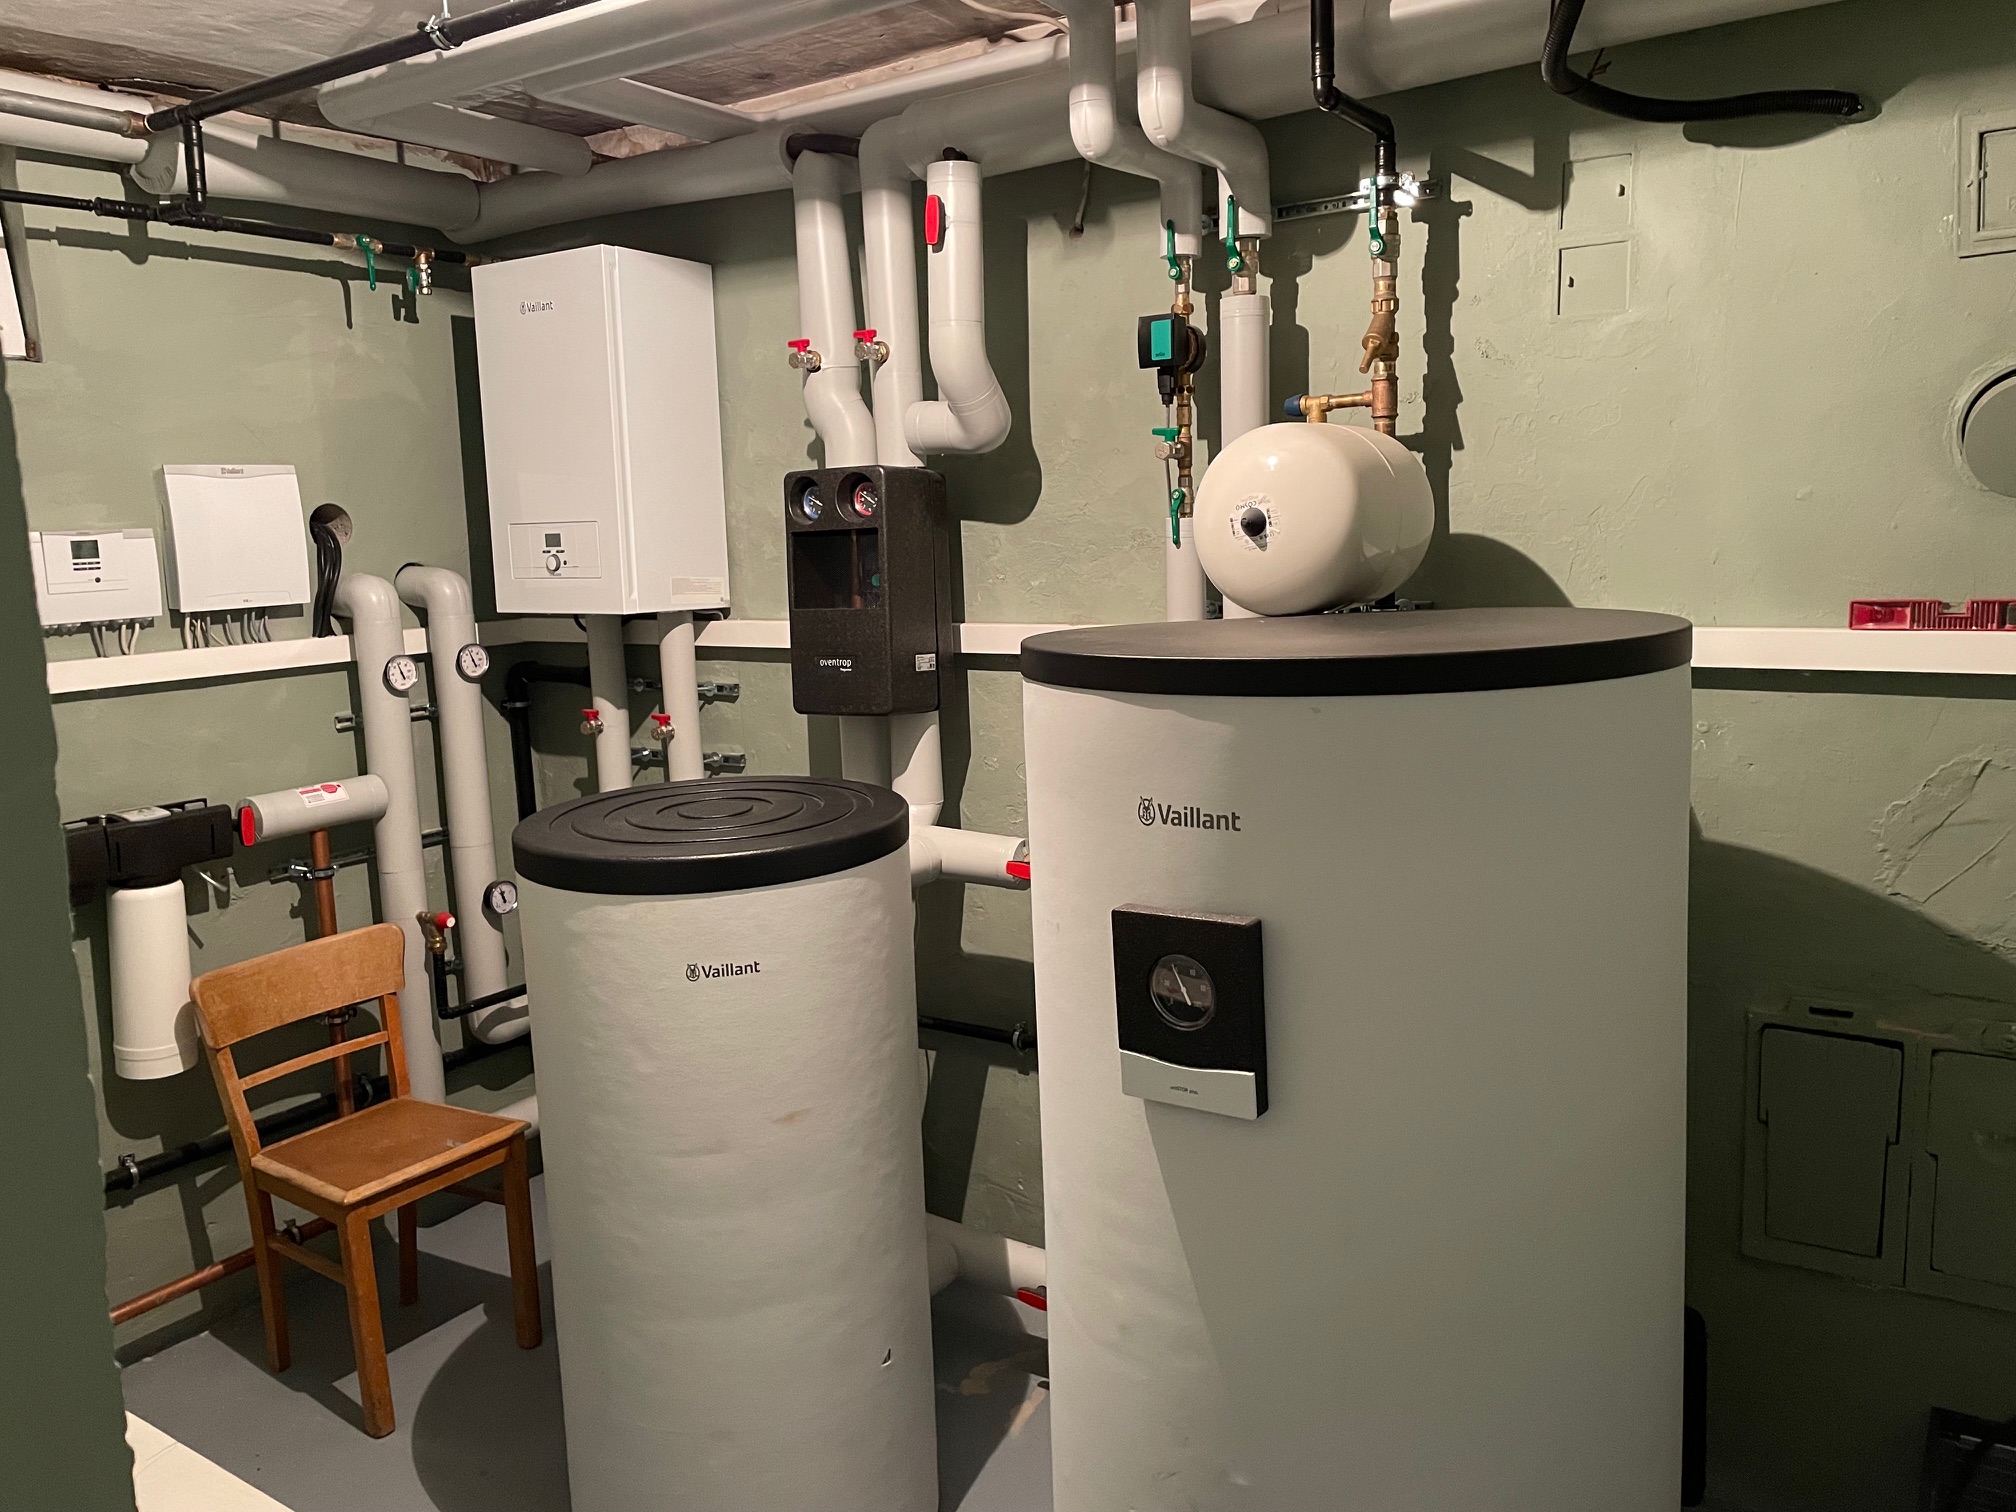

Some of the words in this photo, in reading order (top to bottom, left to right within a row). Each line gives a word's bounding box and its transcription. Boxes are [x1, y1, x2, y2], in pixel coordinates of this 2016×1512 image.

[526, 301, 554, 312] Vaillant
[819, 658, 852, 668] oventrop
[1157, 802, 1241, 832] Vaillant
[701, 960, 761, 979] Vaillant
